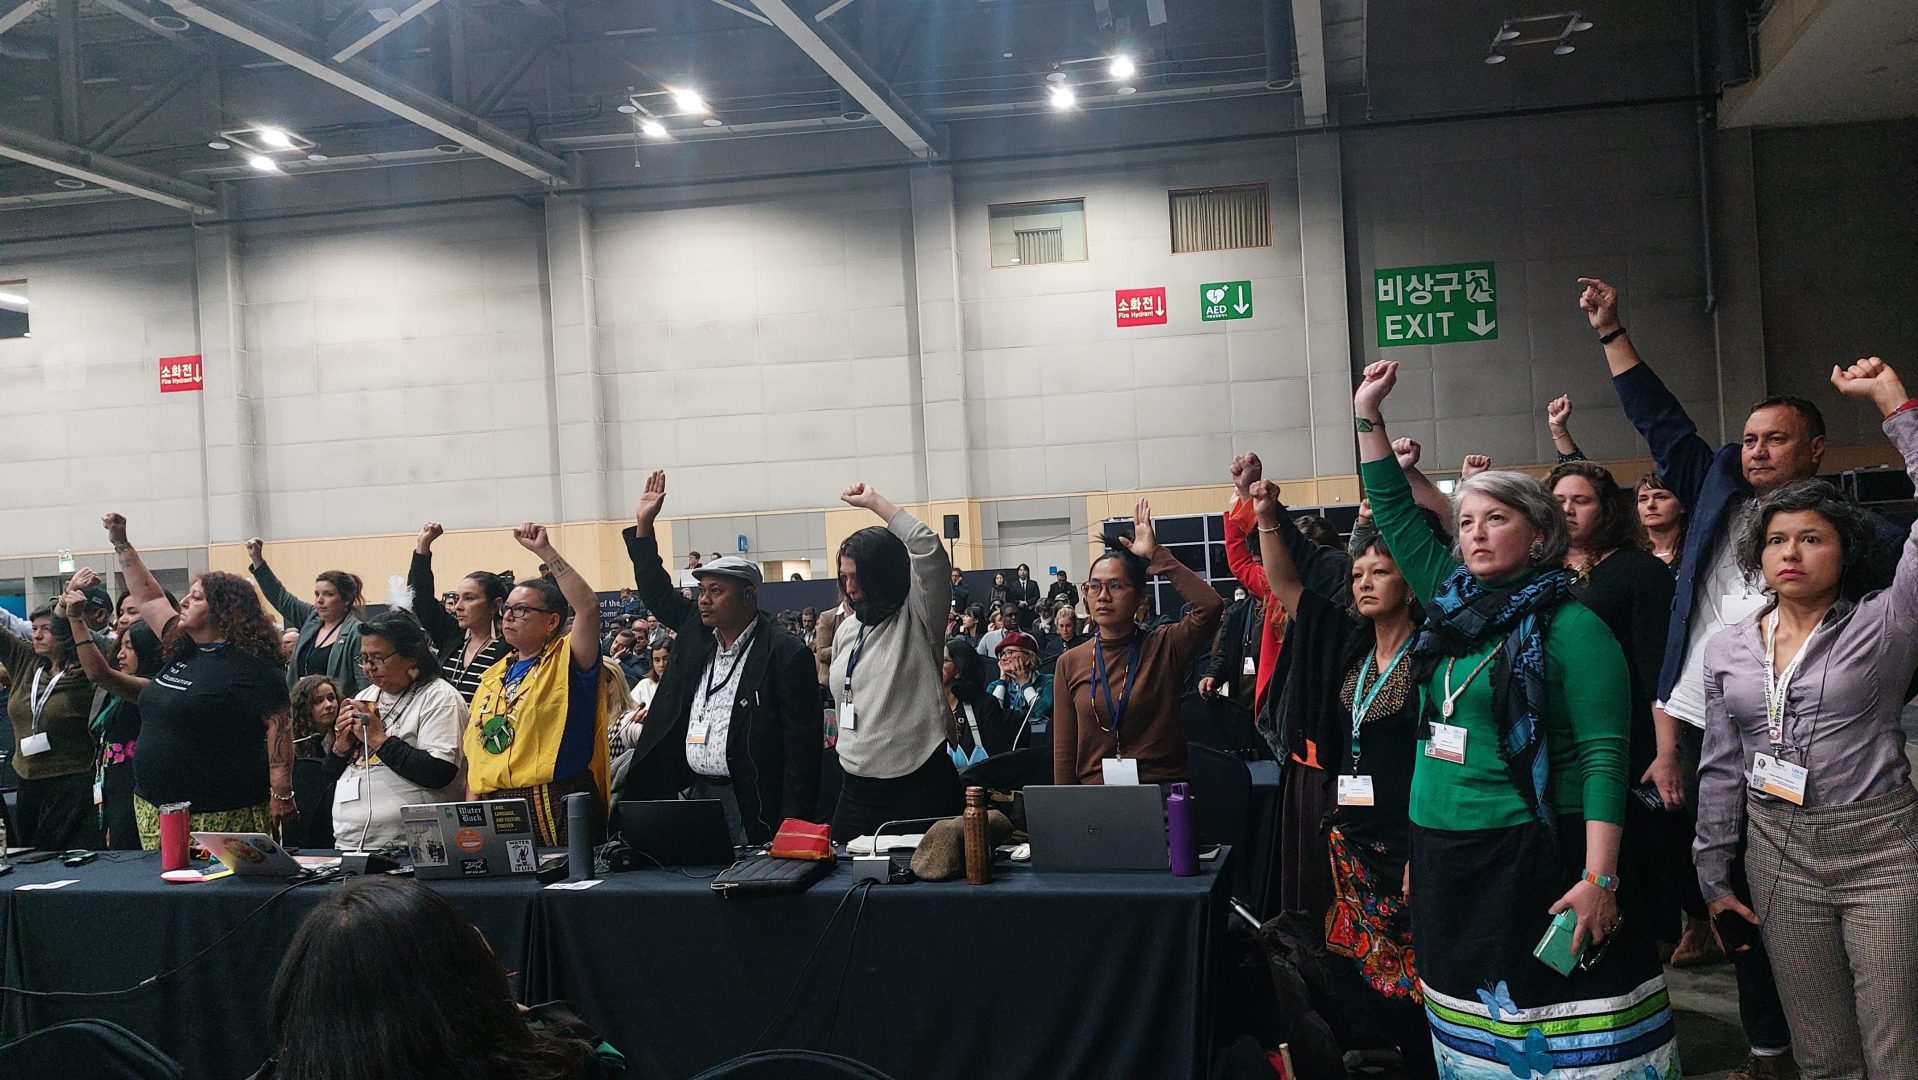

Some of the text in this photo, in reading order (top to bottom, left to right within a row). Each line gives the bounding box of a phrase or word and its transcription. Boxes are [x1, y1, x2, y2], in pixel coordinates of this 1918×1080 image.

[1378, 272, 1462, 306] 비상구
[1118, 295, 1154, 311] 소화전
[1206, 305, 1227, 315] AED
[1131, 310, 1154, 318] Hydrant
[1386, 312, 1455, 340] EXIT
[161, 363, 192, 378] 소화전
